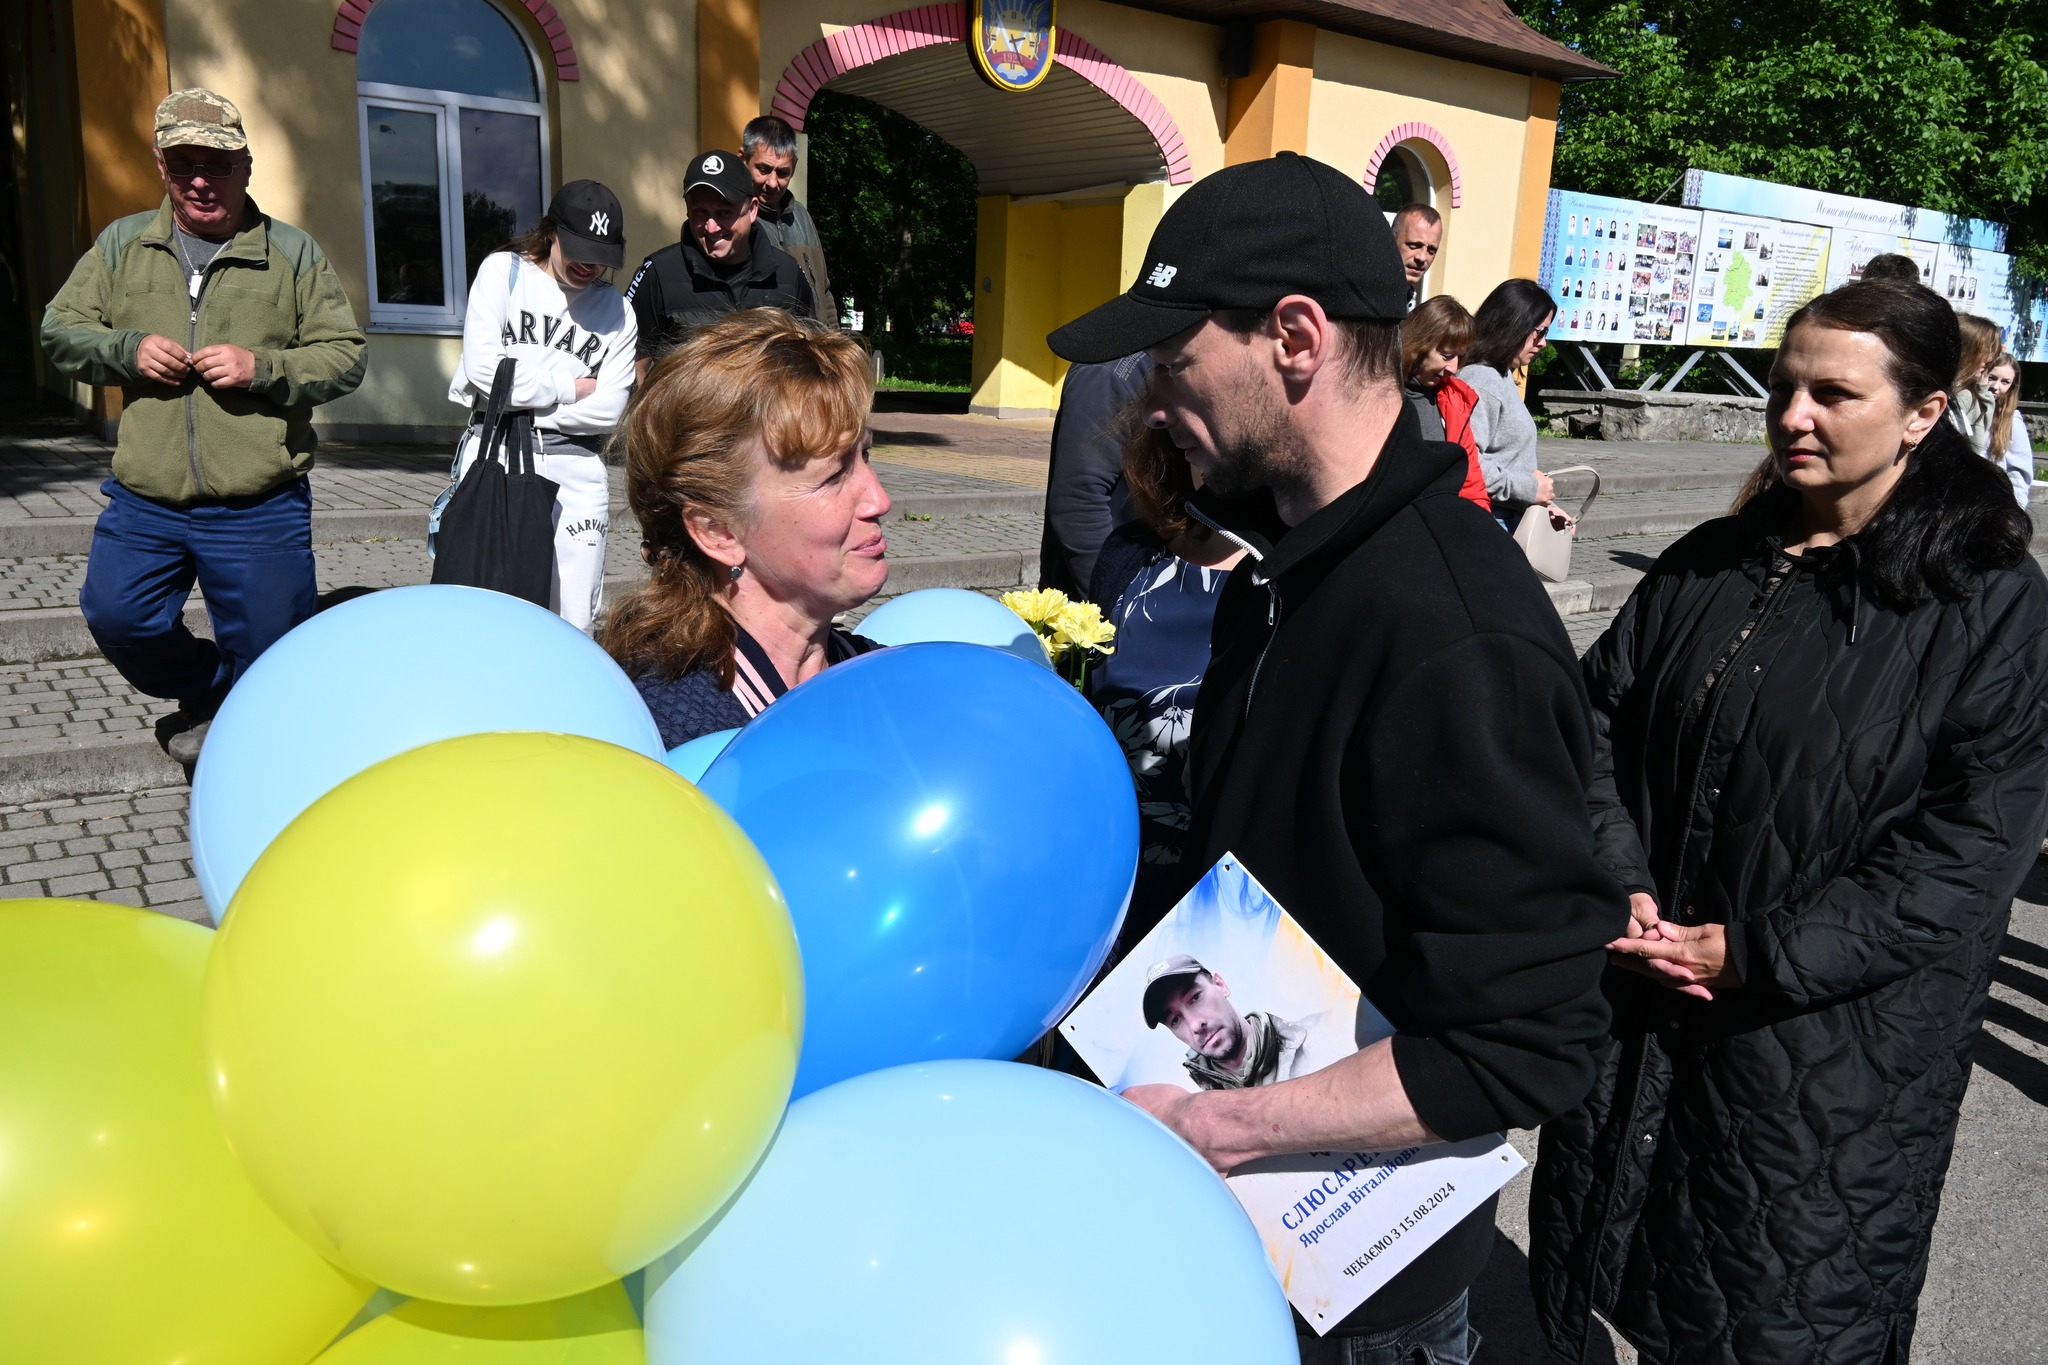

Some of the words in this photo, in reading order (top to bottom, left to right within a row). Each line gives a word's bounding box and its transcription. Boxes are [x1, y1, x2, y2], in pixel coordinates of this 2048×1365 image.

[589, 210, 610, 236] NY
[501, 308, 610, 376] ARVAR
[1299, 1201, 1352, 1249] Ярослав
[1347, 1146, 1421, 1205] Віталійови
[1343, 1235, 1393, 1278] ЧЕКАЄМО
[1399, 1182, 1456, 1232] 15.08.2024
